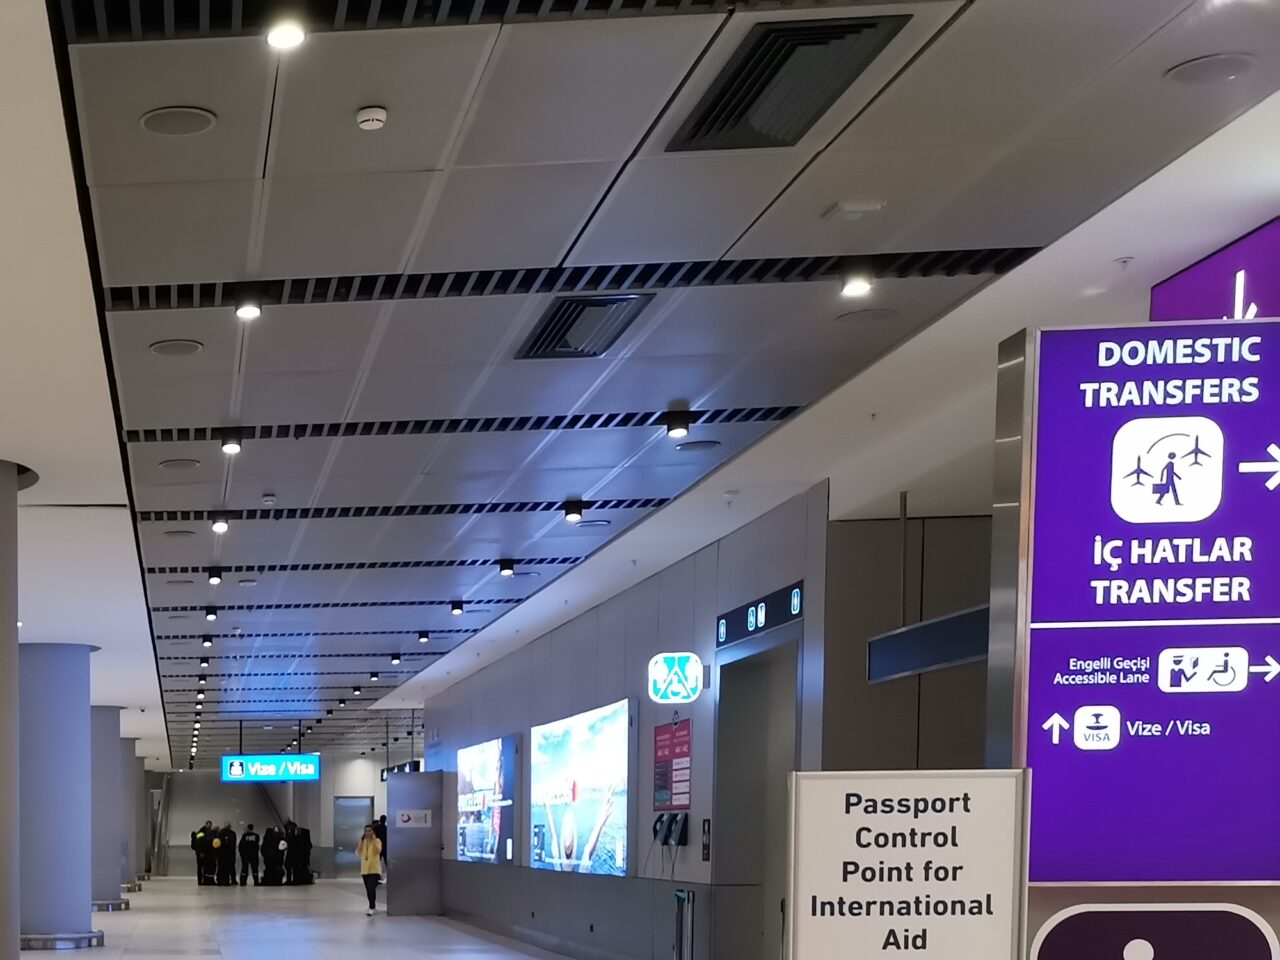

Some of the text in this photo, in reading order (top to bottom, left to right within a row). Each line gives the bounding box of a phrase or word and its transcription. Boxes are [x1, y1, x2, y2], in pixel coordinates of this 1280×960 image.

[1098, 336, 1262, 367] DOMESTIC
[1080, 377, 1260, 408] TRANSFERS
[1093, 534, 1253, 571] İÇ HATLAR
[1090, 577, 1251, 605] TRANSFER
[1069, 657, 1150, 672] Engelli Geçişi
[1053, 671, 1150, 685] Accessible Lane
[1083, 733, 1110, 742] VISA
[1126, 720, 1162, 736] Vize
[1176, 719, 1211, 735] Visa
[248, 762, 276, 776] Vize
[287, 761, 315, 775] Visa
[844, 792, 971, 819] Passport
[855, 825, 959, 848] Control
[842, 861, 964, 882] Point for
[810, 894, 994, 917] International
[881, 928, 928, 950] Aid
